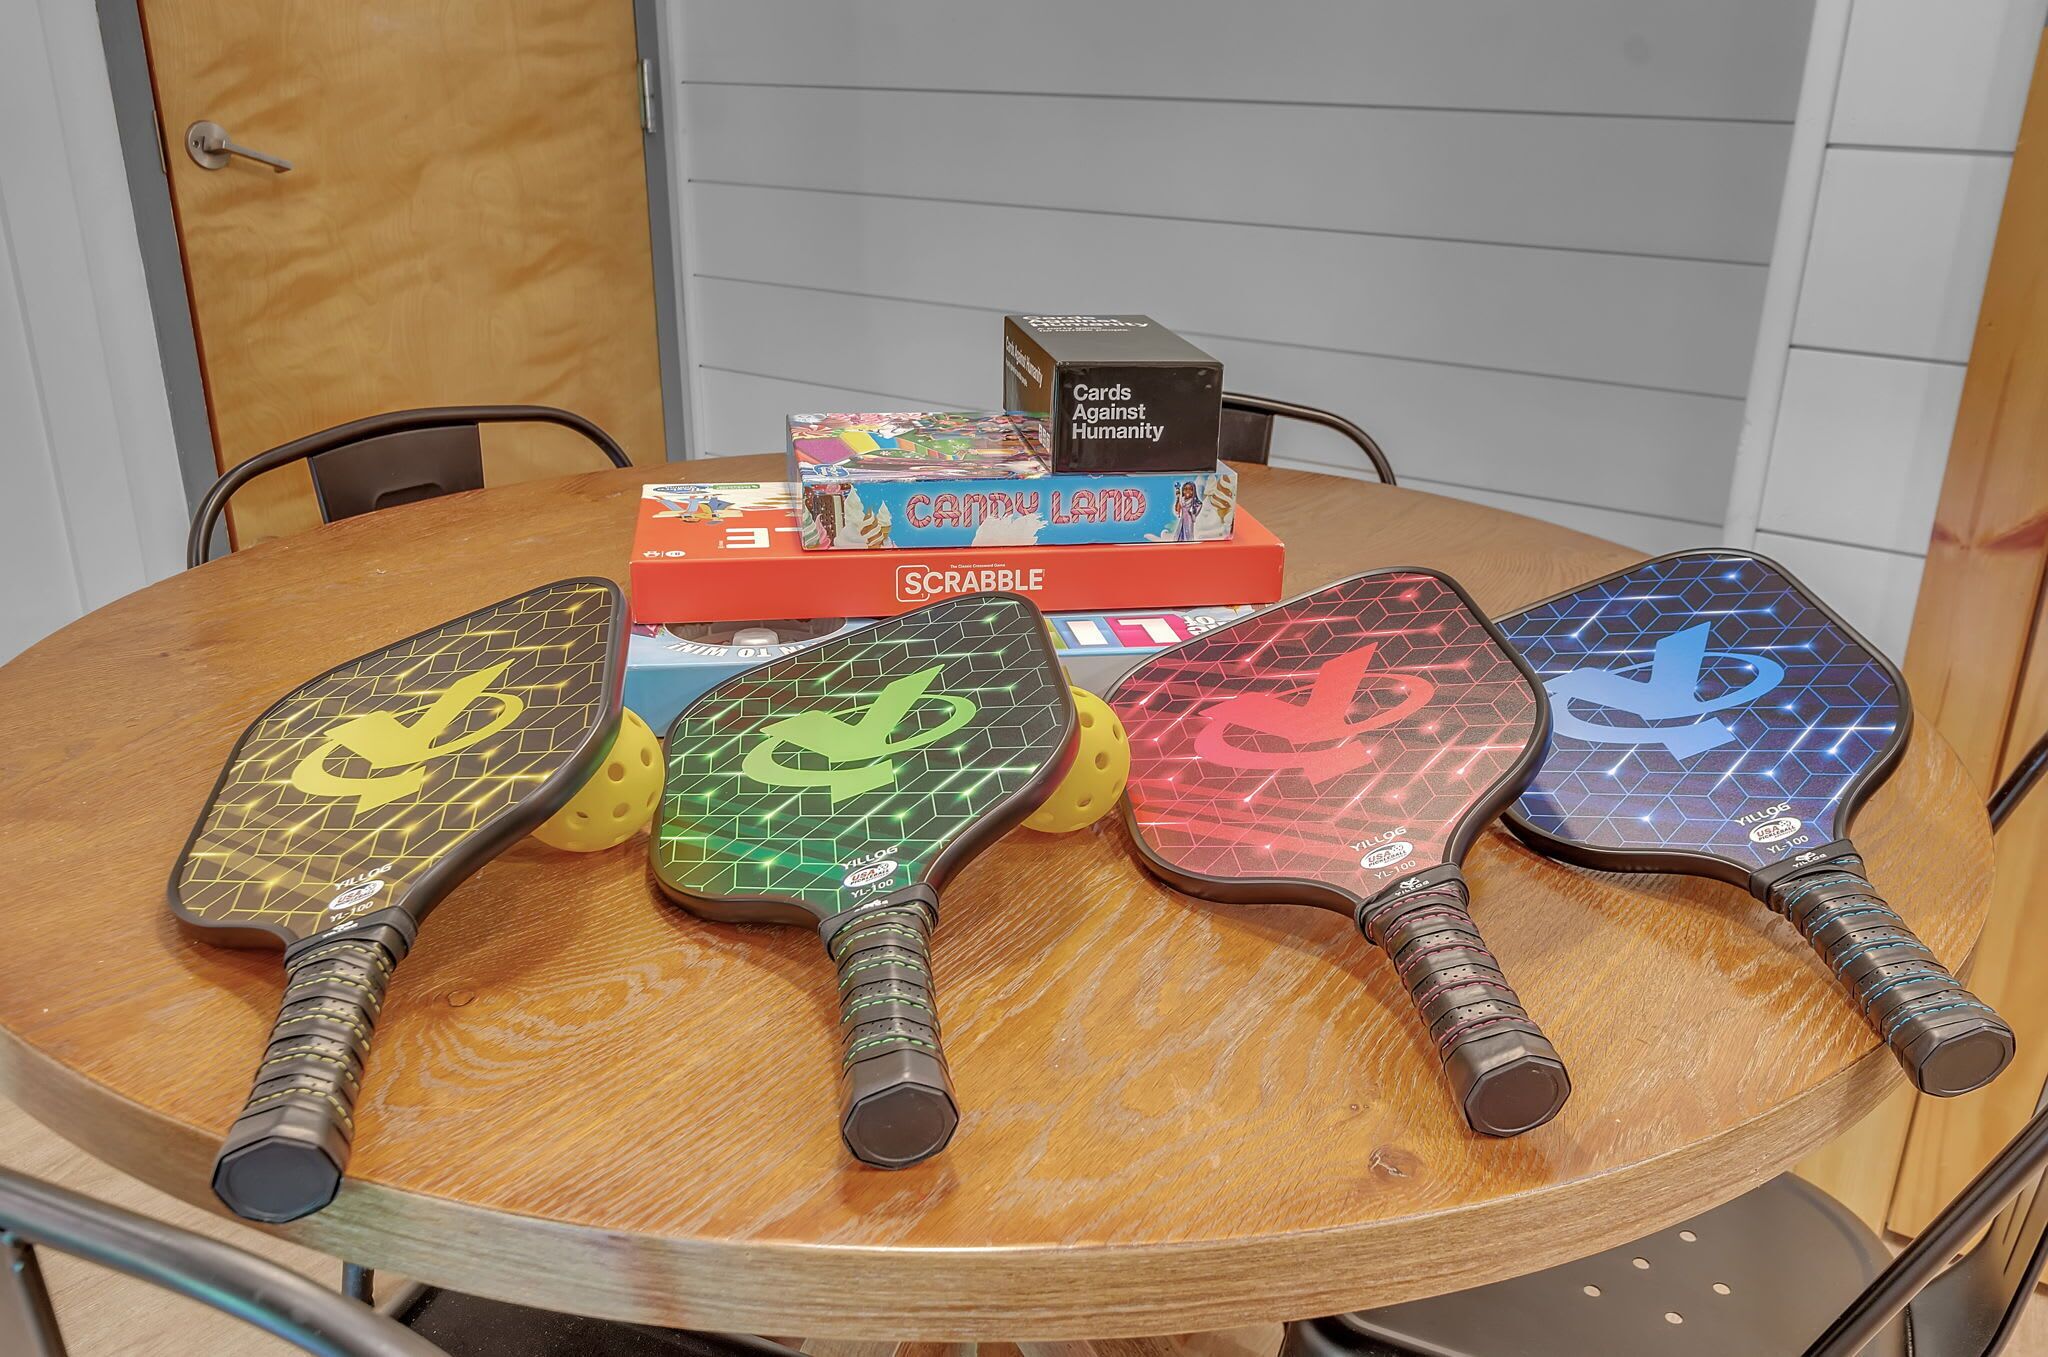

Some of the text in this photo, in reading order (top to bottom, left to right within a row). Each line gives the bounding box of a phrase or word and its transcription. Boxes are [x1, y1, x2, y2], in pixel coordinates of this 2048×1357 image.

[1073, 383, 1132, 402] Cards
[1072, 403, 1147, 424] Against
[1072, 422, 1165, 442] Humanity
[906, 489, 1147, 529] CANDY LAND
[905, 568, 1044, 595] SCRABBLE
[1066, 617, 1184, 646] LI
[665, 641, 729, 658] WIN!
[737, 648, 772, 658] TO
[1734, 802, 1791, 827] YILLOG
[1349, 826, 1407, 852] YILLOG
[1756, 826, 1780, 837] USA
[1758, 825, 1796, 841] PICKLEBALL
[1766, 835, 1809, 854] YL-100
[841, 846, 899, 870] YILLOG
[1367, 850, 1391, 863] USA
[1792, 853, 1827, 868] YILLOG
[335, 862, 393, 891] YILLOG
[851, 869, 876, 880] USA
[1374, 860, 1417, 880] YL-100
[851, 879, 894, 898] YL-100
[1395, 880, 1430, 897] YILLOG
[329, 901, 374, 922] YL-100
